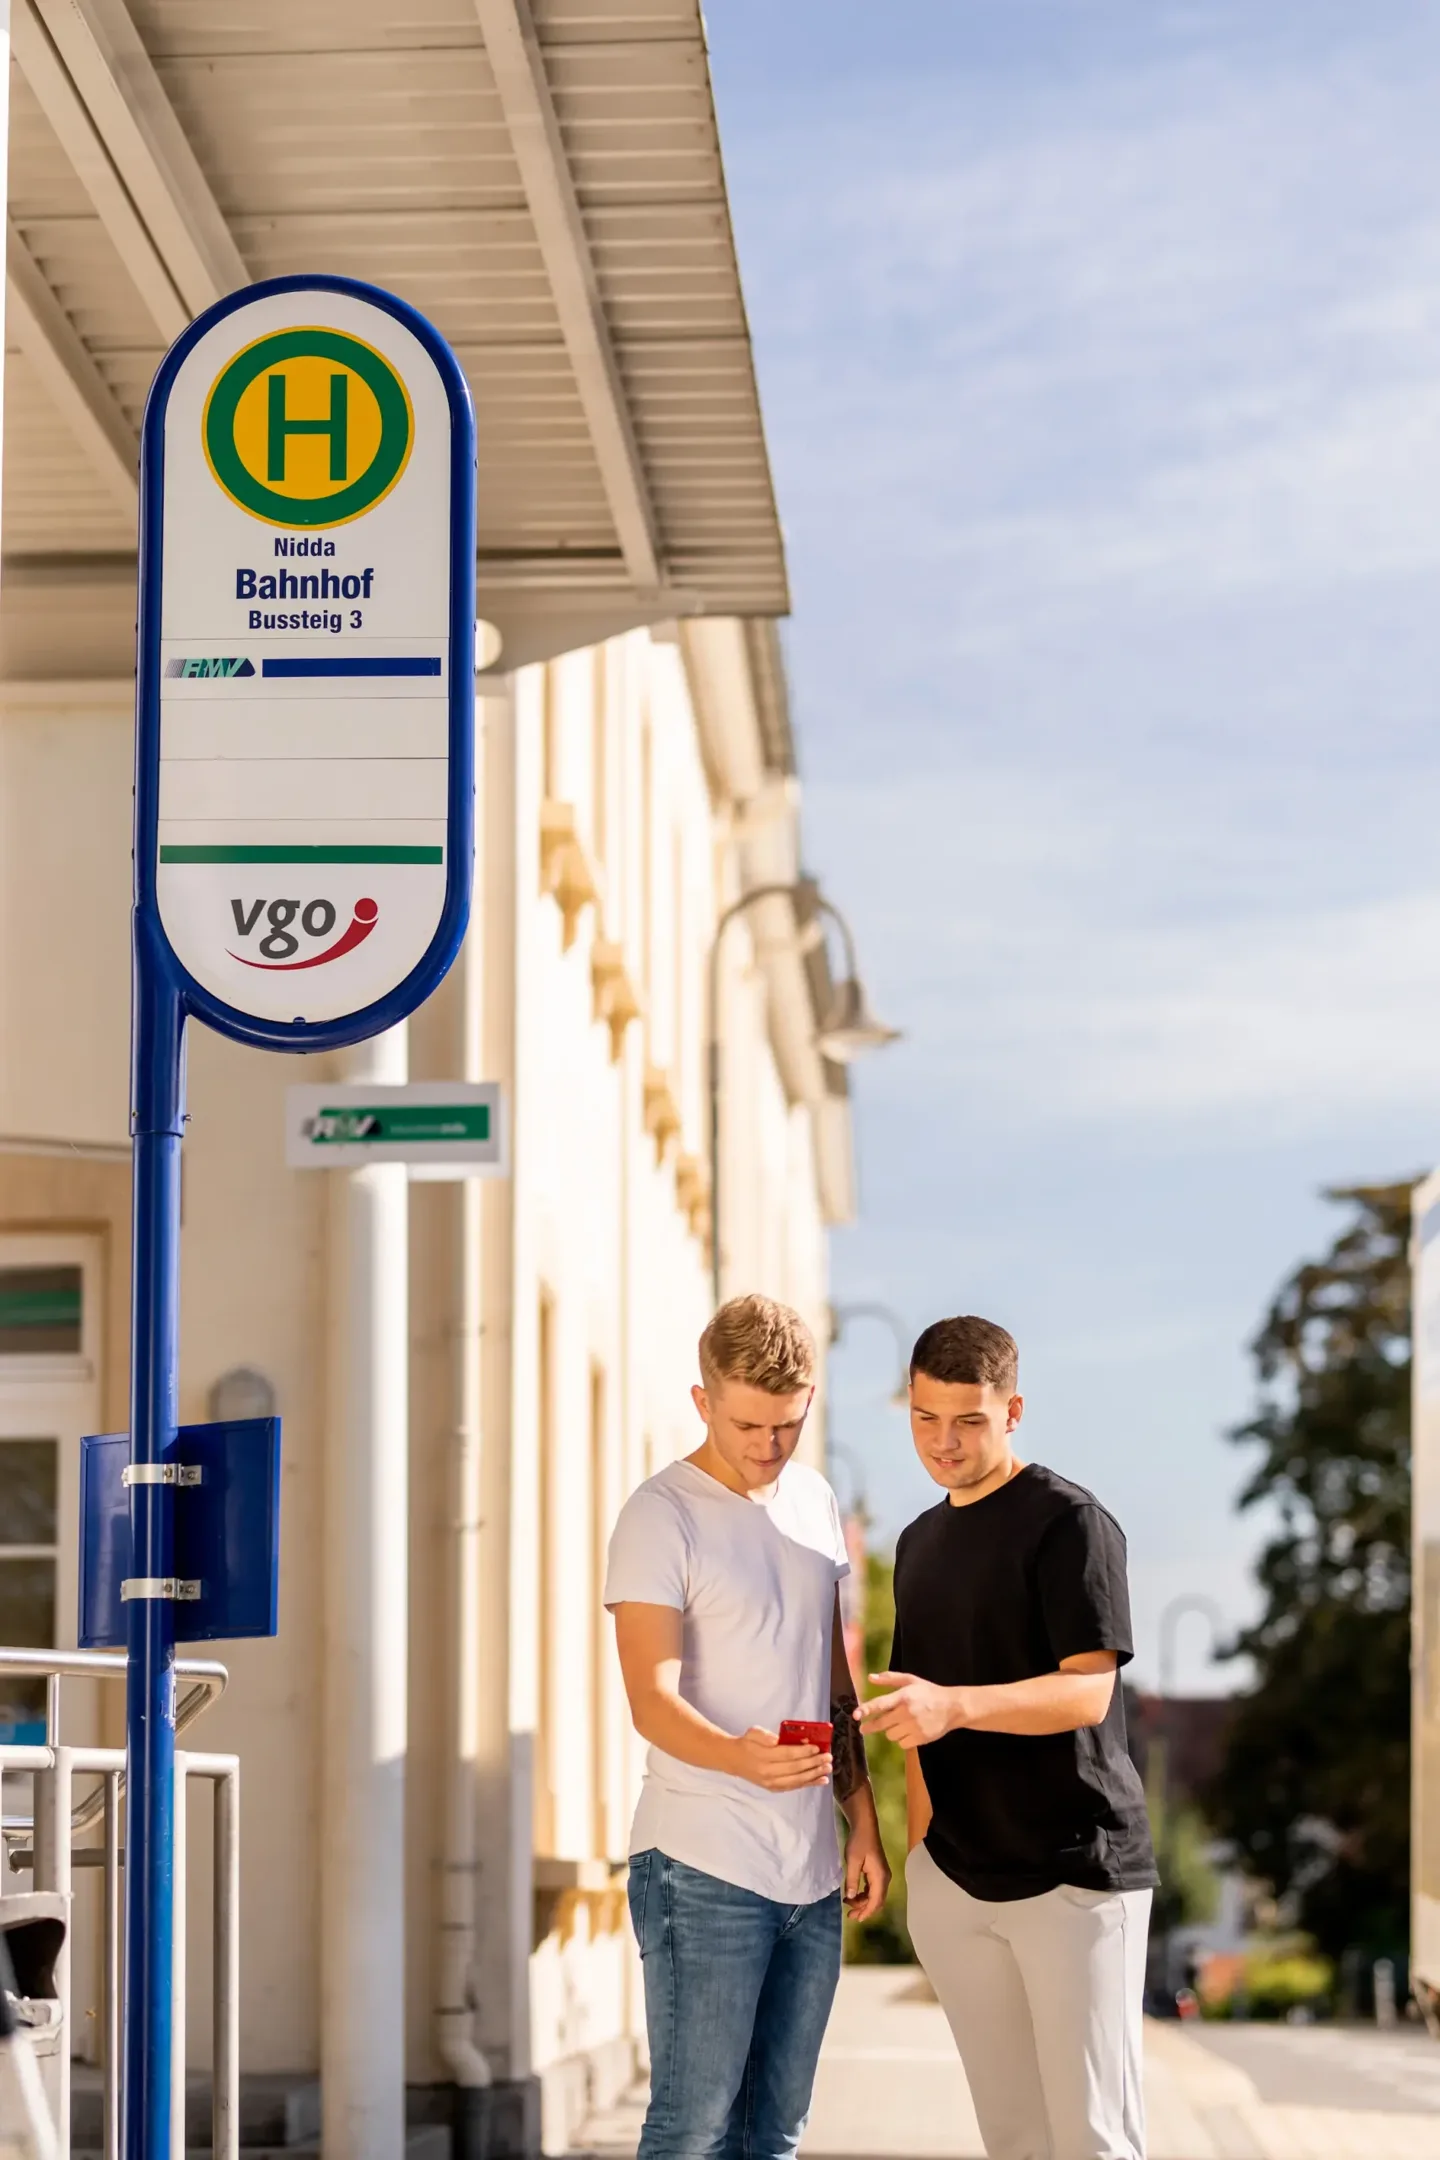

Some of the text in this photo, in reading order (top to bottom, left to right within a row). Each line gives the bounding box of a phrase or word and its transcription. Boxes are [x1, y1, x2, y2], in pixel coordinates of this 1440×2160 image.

[267, 374, 348, 481] H
[274, 538, 336, 557] Nidda
[235, 568, 374, 600] Bahnhof
[249, 609, 363, 633] Bussteig 3
[181, 658, 247, 678] RMV
[230, 899, 336, 960] vgo
